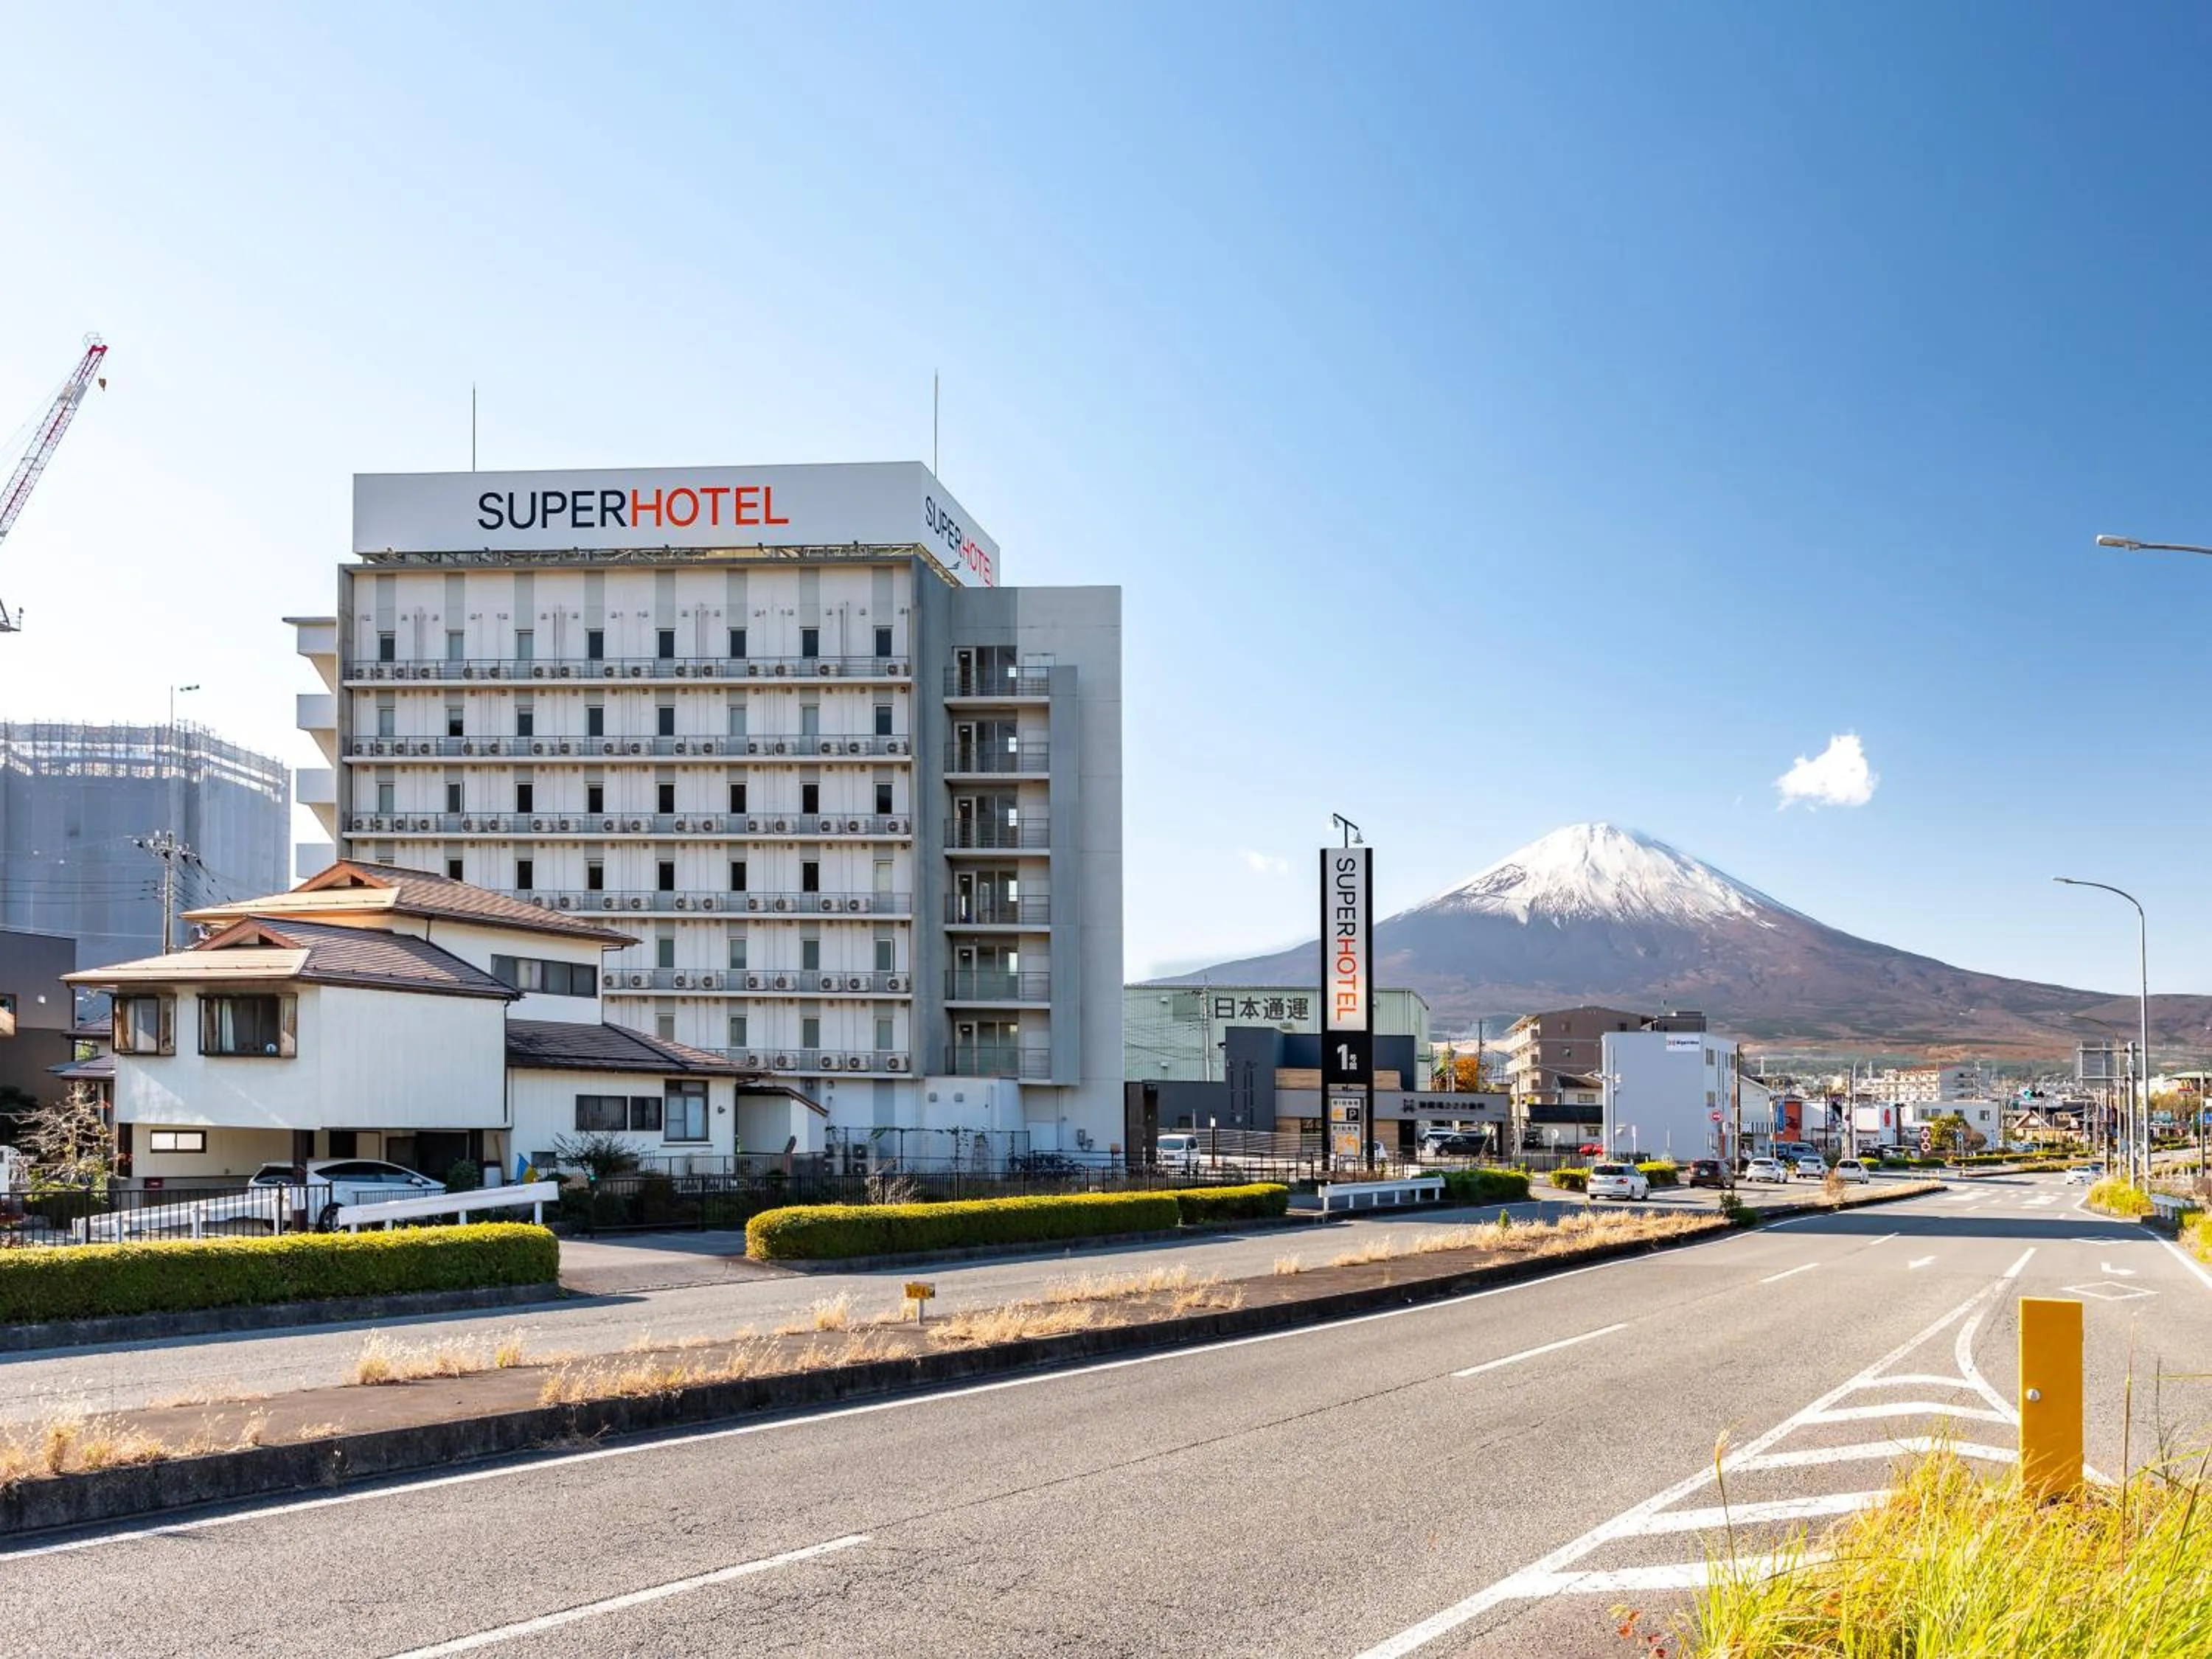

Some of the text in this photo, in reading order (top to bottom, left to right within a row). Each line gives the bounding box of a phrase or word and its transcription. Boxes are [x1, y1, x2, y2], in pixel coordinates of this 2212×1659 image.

[478, 486, 790, 530] SUPERHOTEL
[1336, 858, 1357, 1021] SUPERHOTEL
[1214, 997, 1310, 1021] 日本通運
